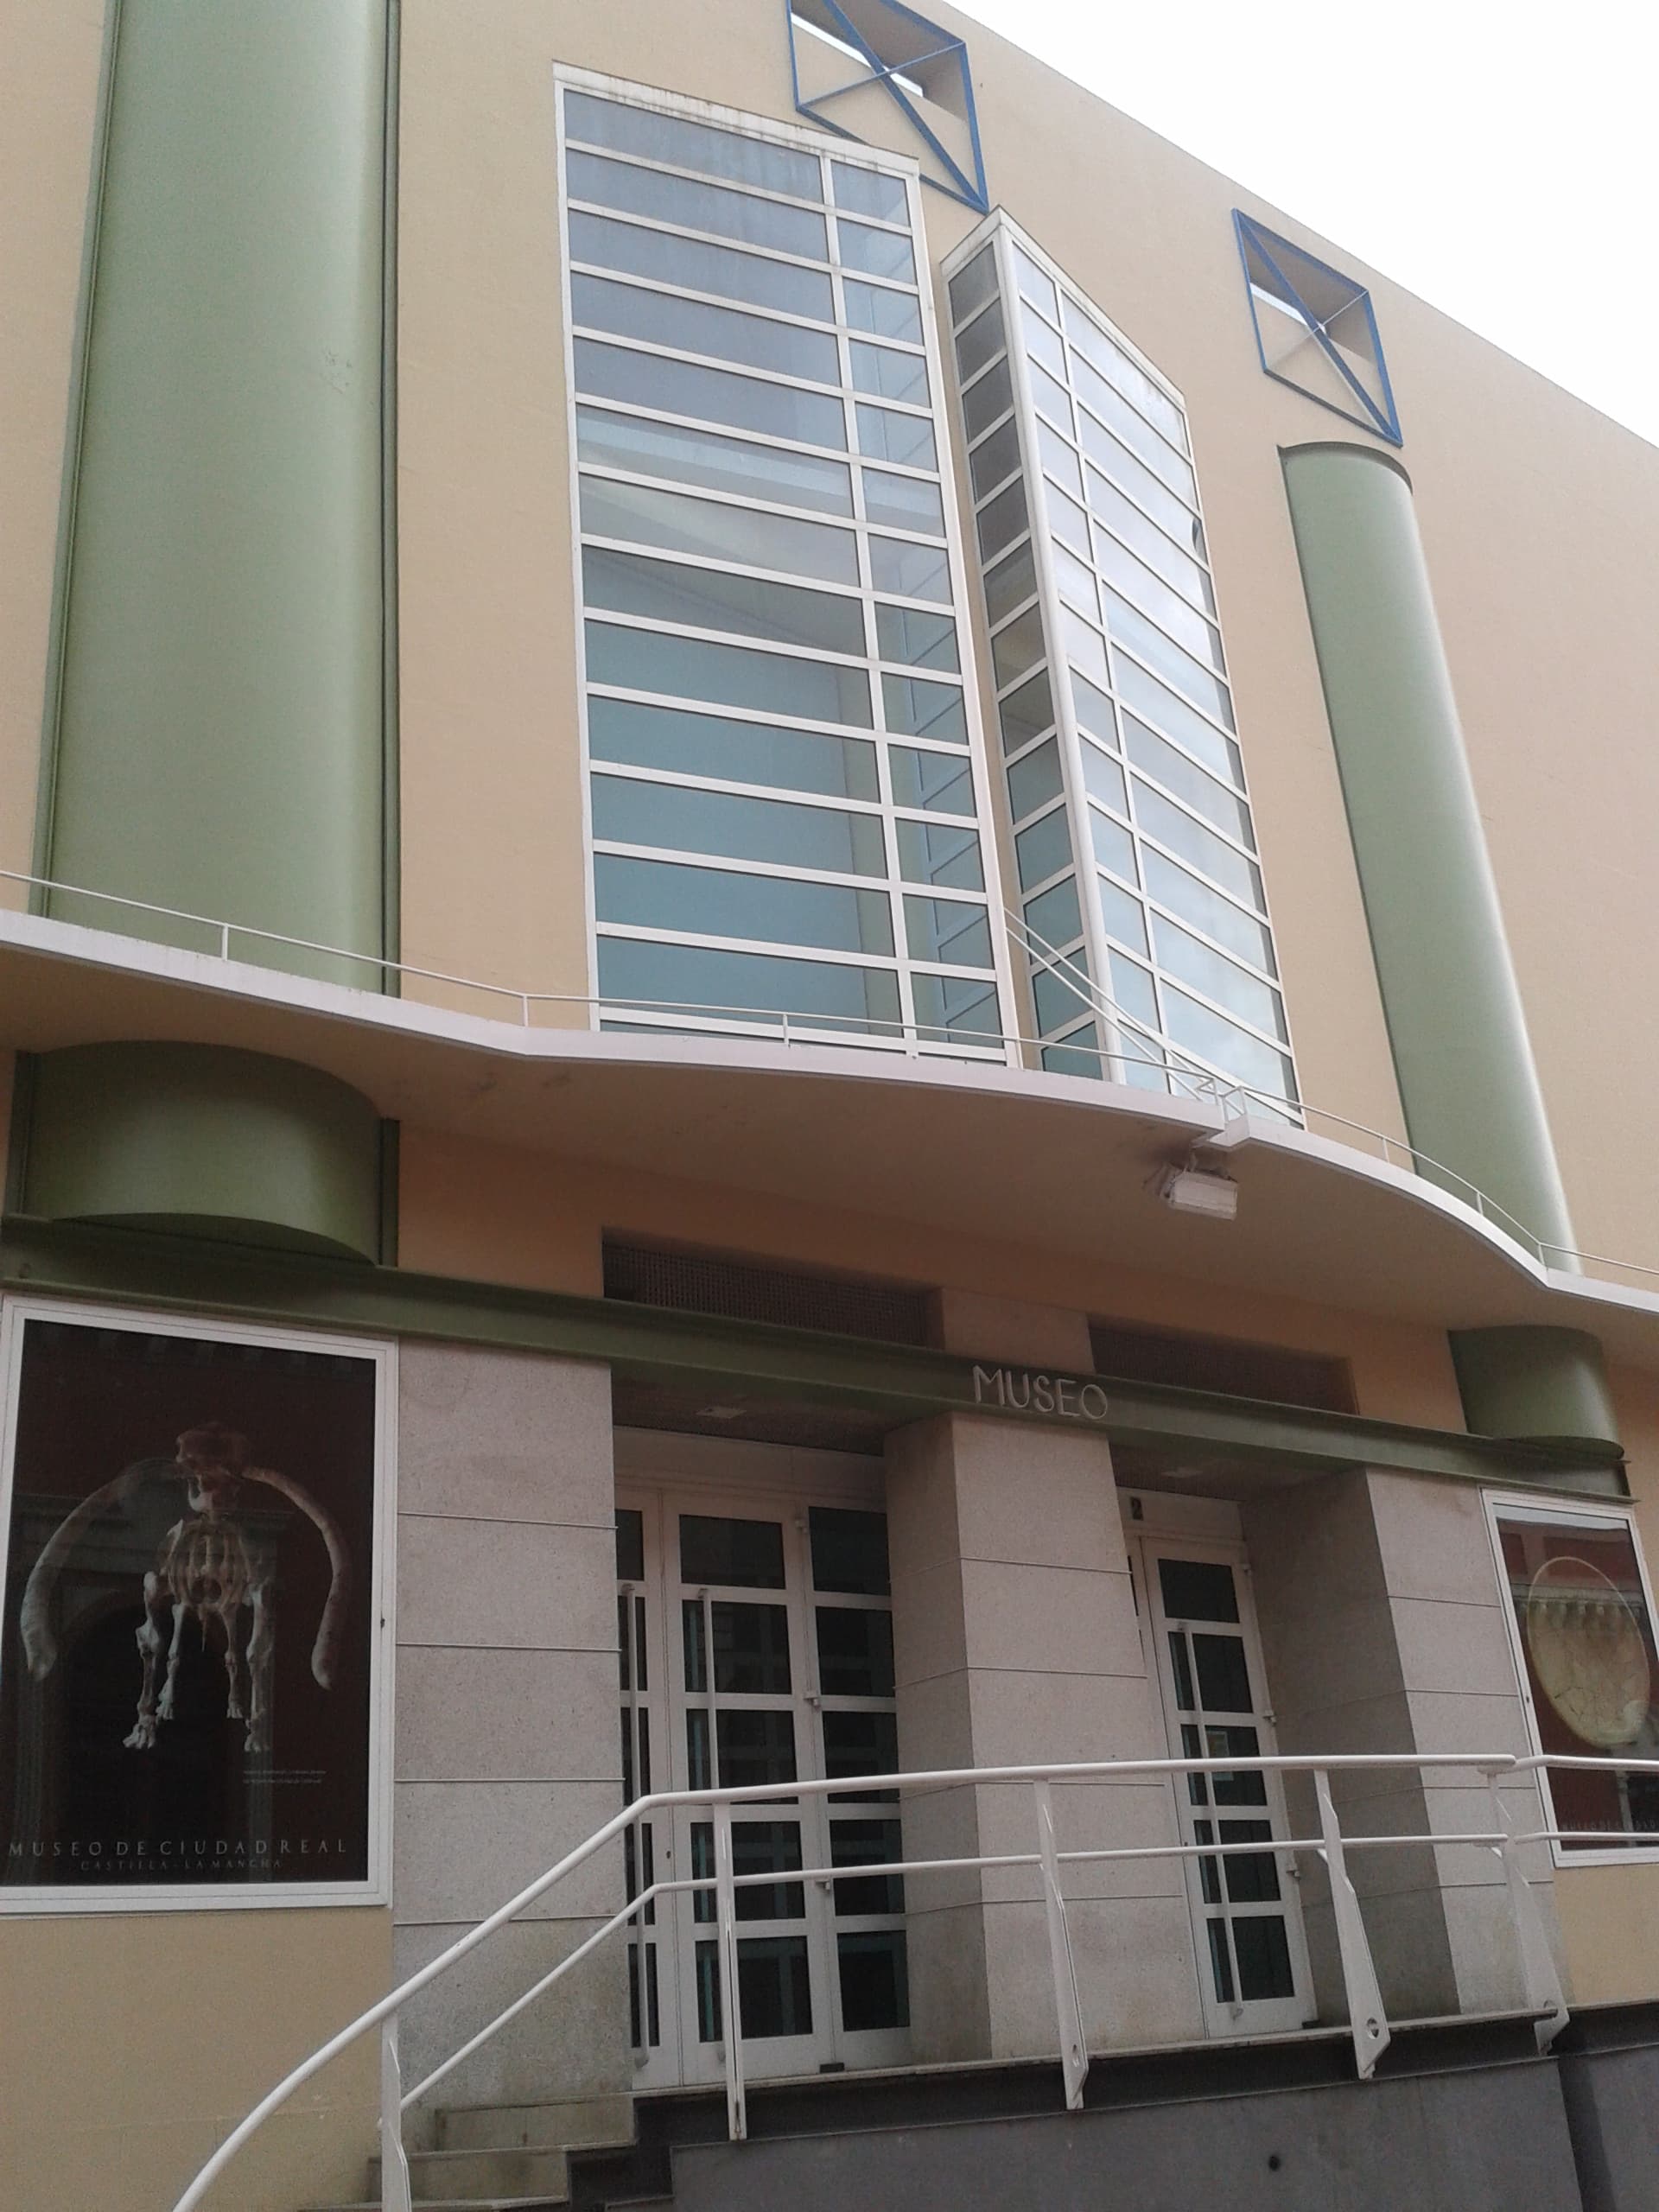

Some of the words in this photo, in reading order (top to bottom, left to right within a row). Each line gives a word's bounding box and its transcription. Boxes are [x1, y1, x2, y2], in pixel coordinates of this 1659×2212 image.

[972, 1364, 1108, 1420] MUSEO
[8, 1840, 102, 1857] MUSEO
[116, 1840, 146, 1856] DE
[160, 1840, 267, 1856] CIUDAD
[280, 1838, 346, 1854] REAL
